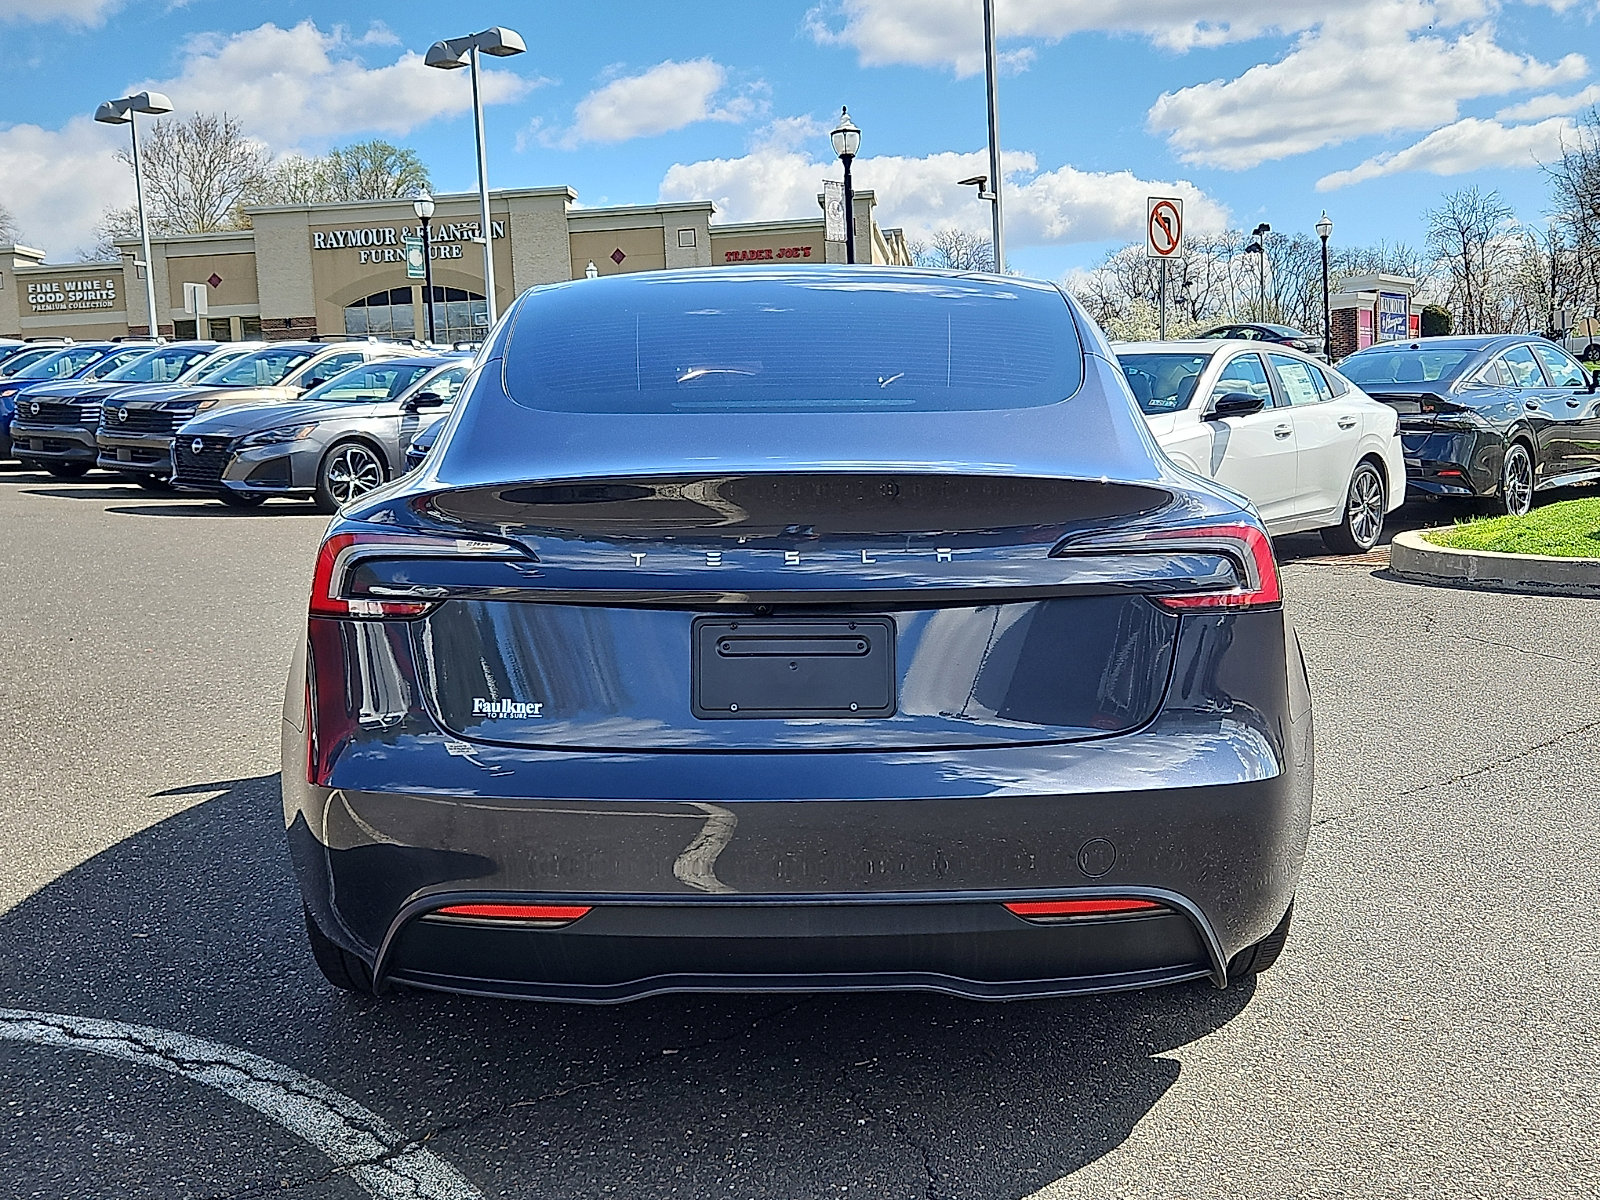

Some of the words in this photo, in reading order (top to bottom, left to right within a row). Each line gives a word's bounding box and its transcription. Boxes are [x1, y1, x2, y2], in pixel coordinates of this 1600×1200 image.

[313, 227, 397, 249] RAYMOUR
[401, 226, 413, 243] &
[359, 245, 463, 264] FURNURE
[725, 249, 774, 262] TRADER
[776, 246, 812, 259] JOE'S
[28, 282, 60, 293] FINE
[64, 280, 101, 291] WINE
[105, 279, 114, 289] &
[28, 292, 65, 304] GOOD
[68, 289, 116, 302] SPIRITS
[32, 302, 67, 312] PREMIUM
[68, 300, 113, 310] COLLECTION
[630, 547, 953, 567] TESLA
[472, 698, 543, 714] Faulkner
